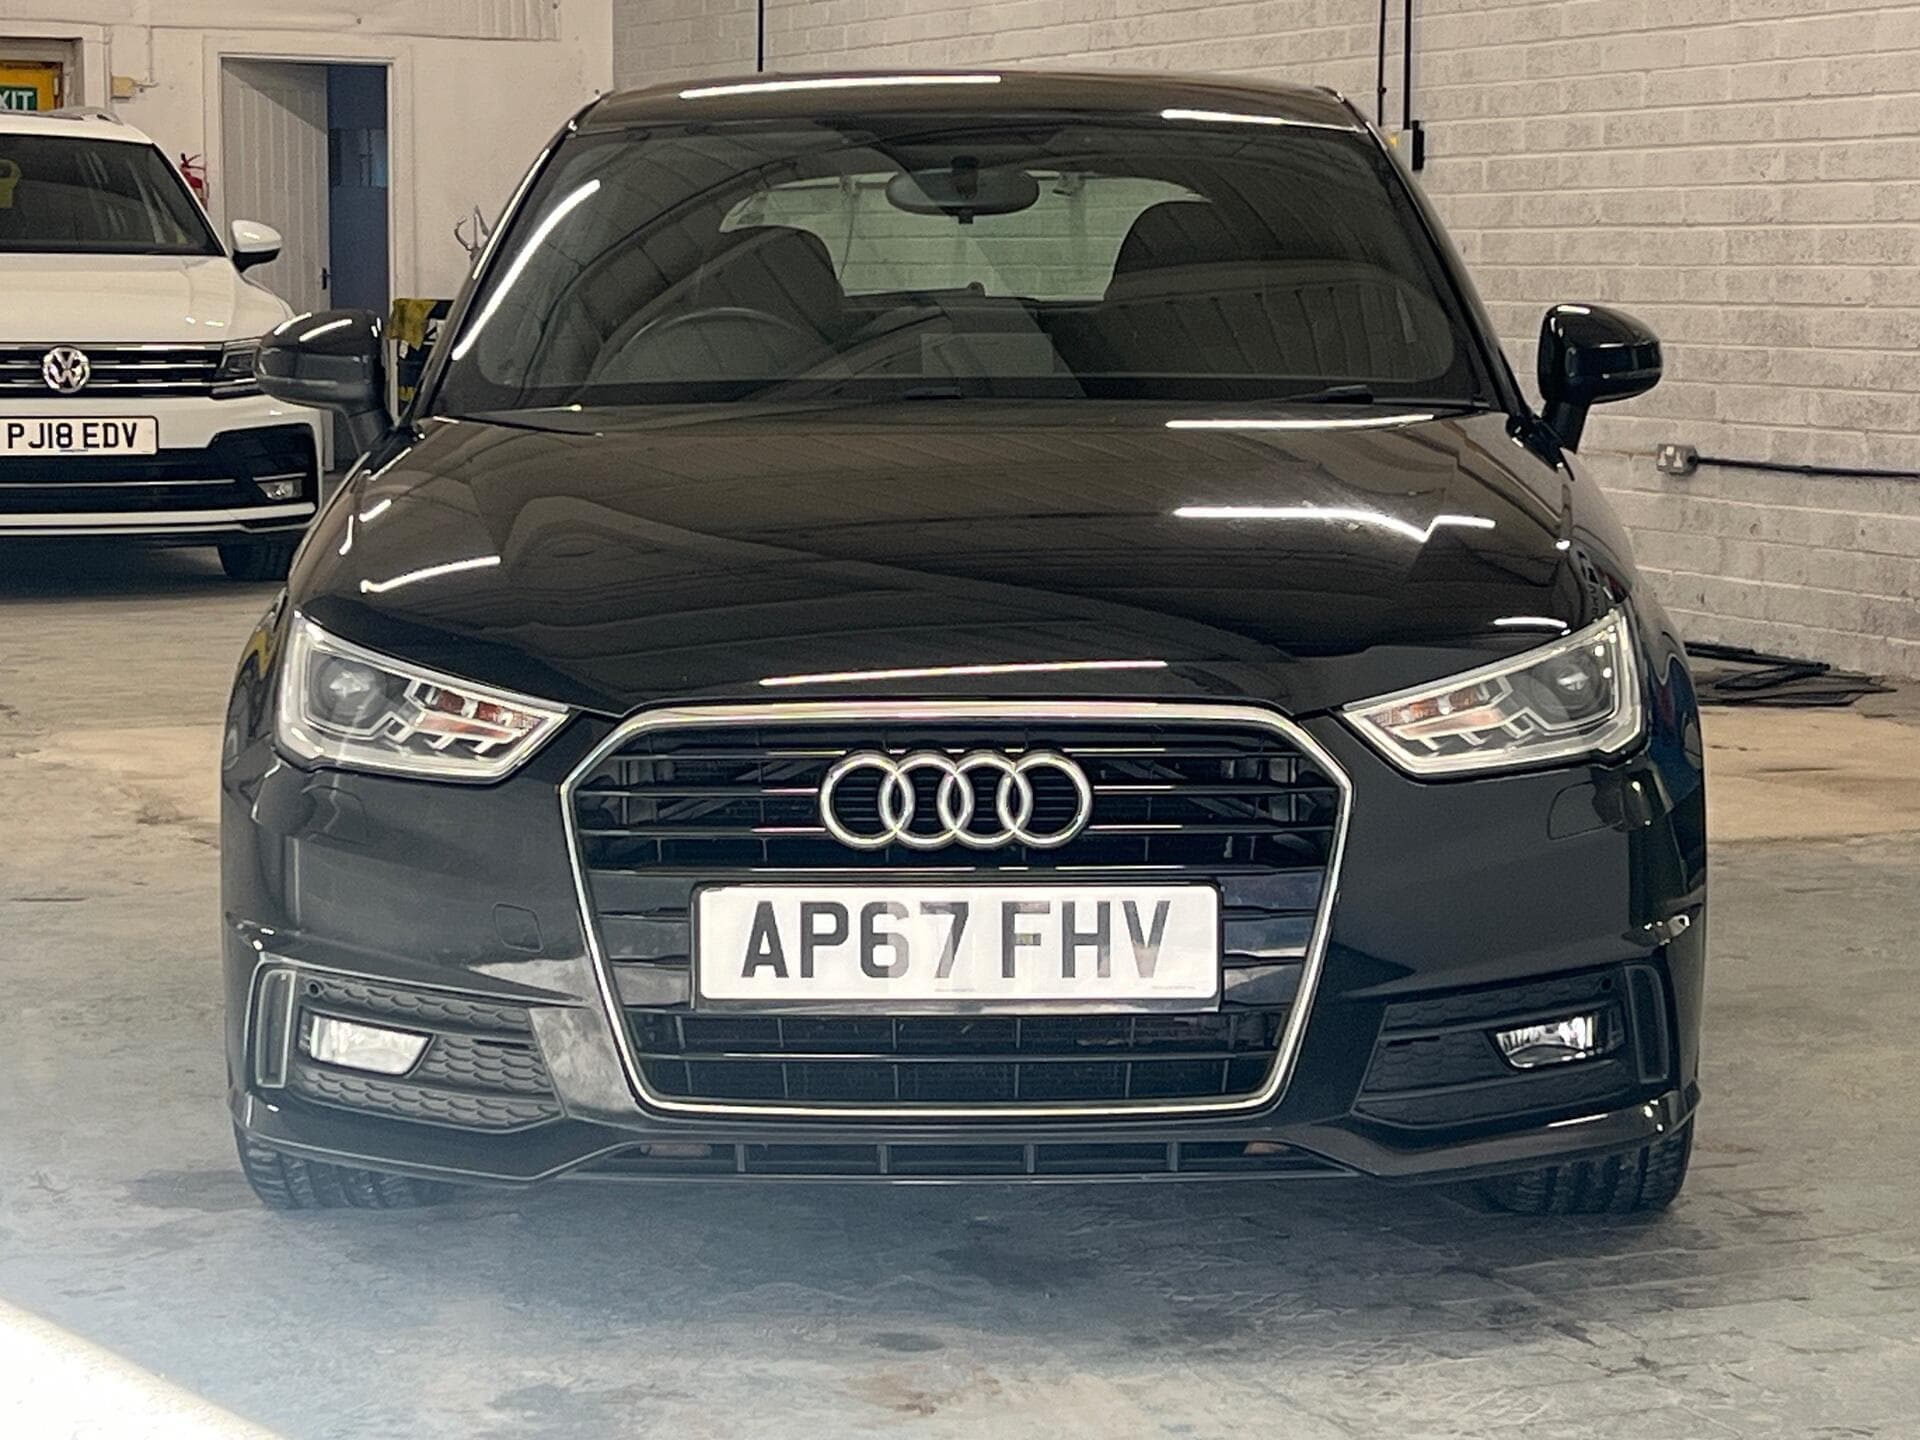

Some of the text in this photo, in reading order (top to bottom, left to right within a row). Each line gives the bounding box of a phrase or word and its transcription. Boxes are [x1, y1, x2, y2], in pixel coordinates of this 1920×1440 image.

[7, 421, 138, 449] PJ18 EDV
[740, 900, 1171, 979] AP67 FHV
